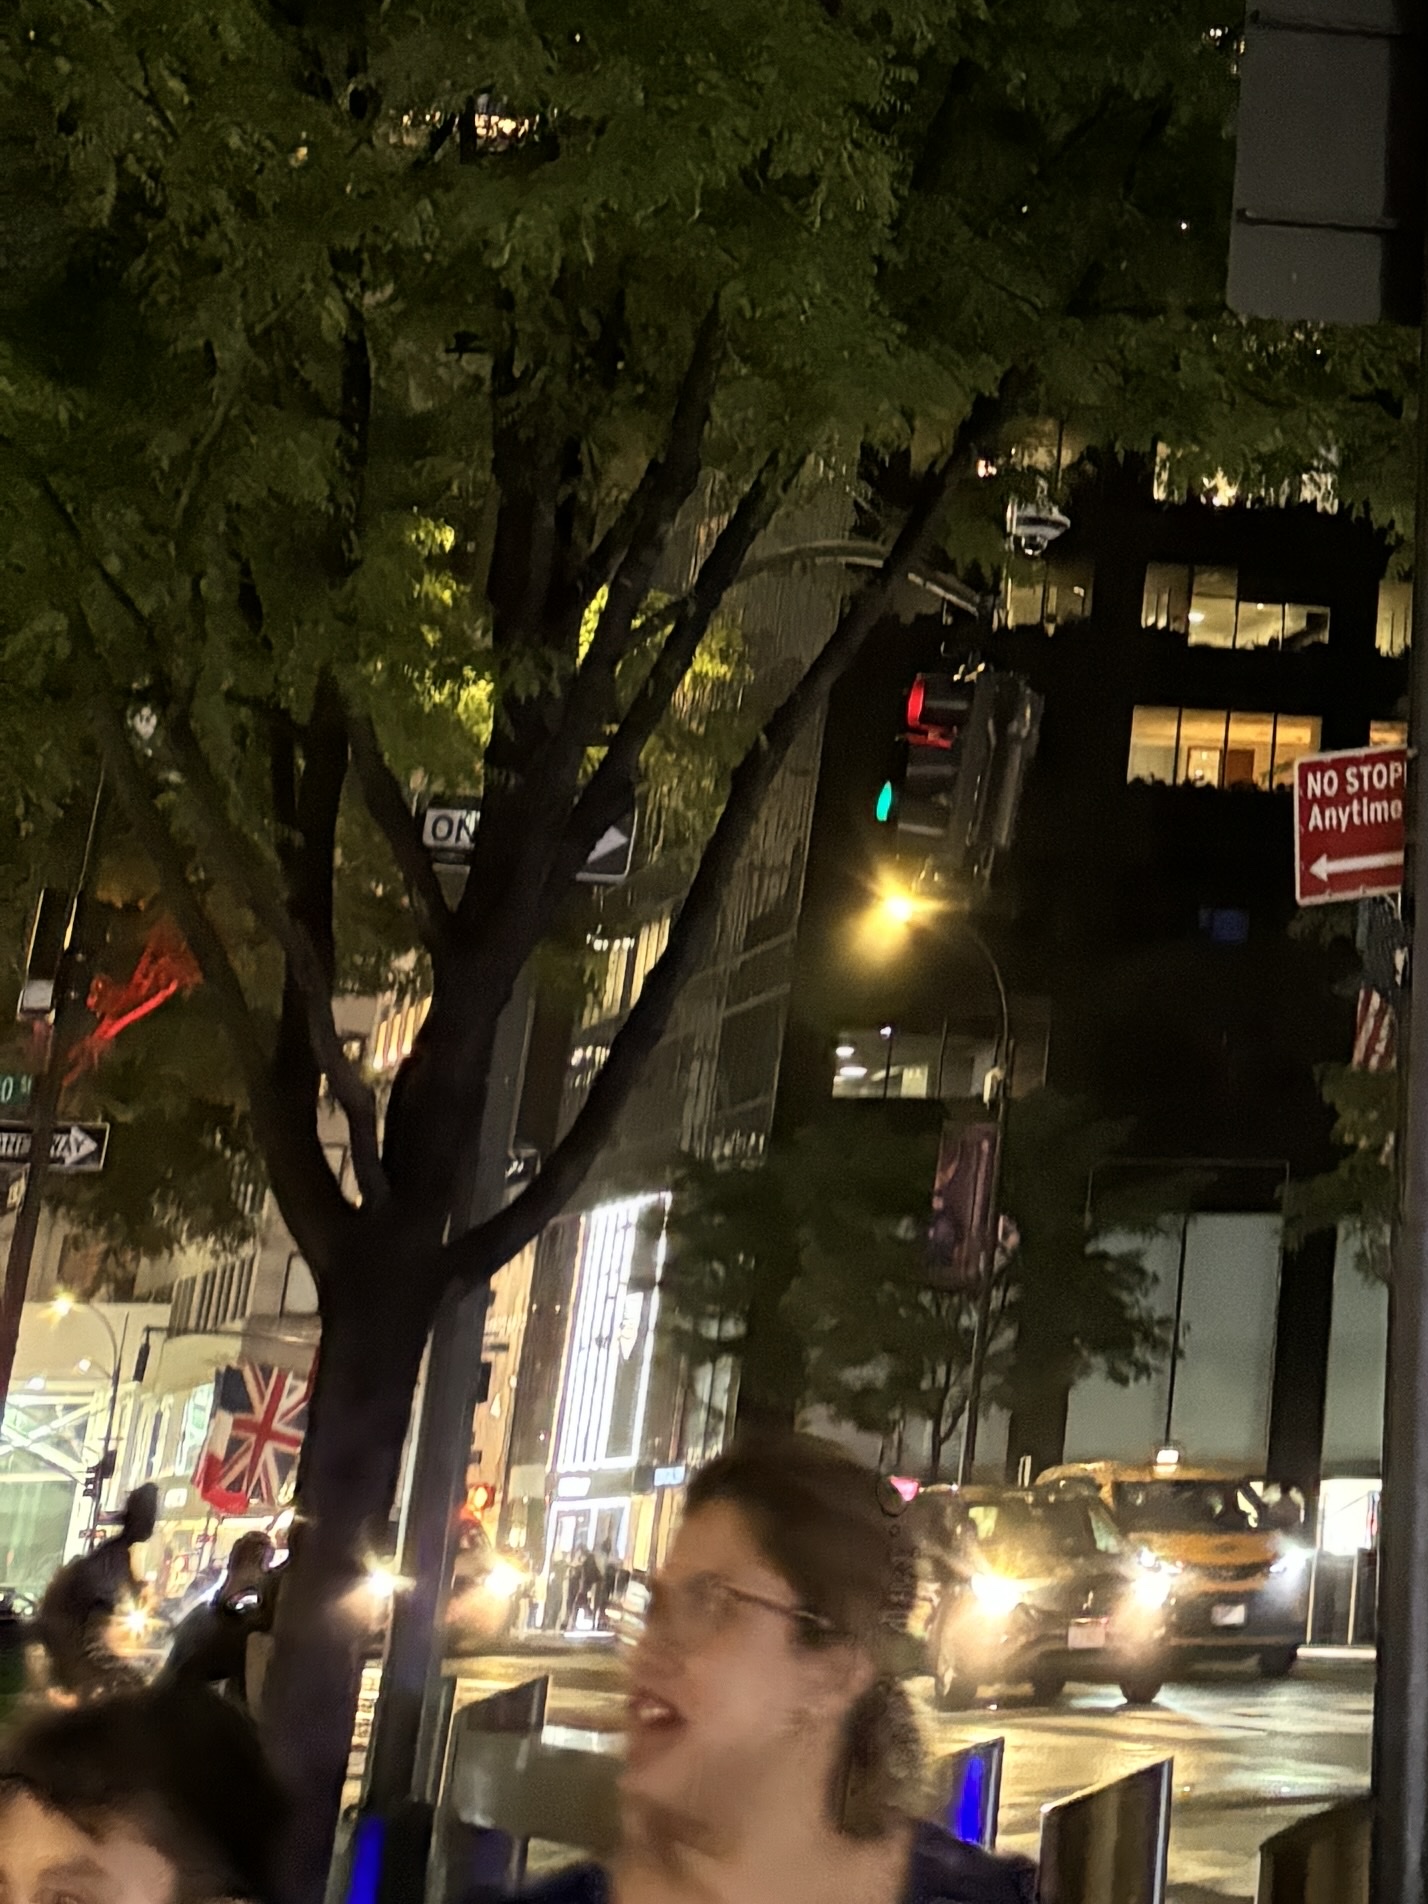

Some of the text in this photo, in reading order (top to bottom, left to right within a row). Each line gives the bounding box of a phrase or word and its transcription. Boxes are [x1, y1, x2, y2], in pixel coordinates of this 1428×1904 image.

[1307, 761, 1407, 799] NO STOP
[431, 810, 476, 844] ON
[1308, 796, 1402, 833] Anytime
